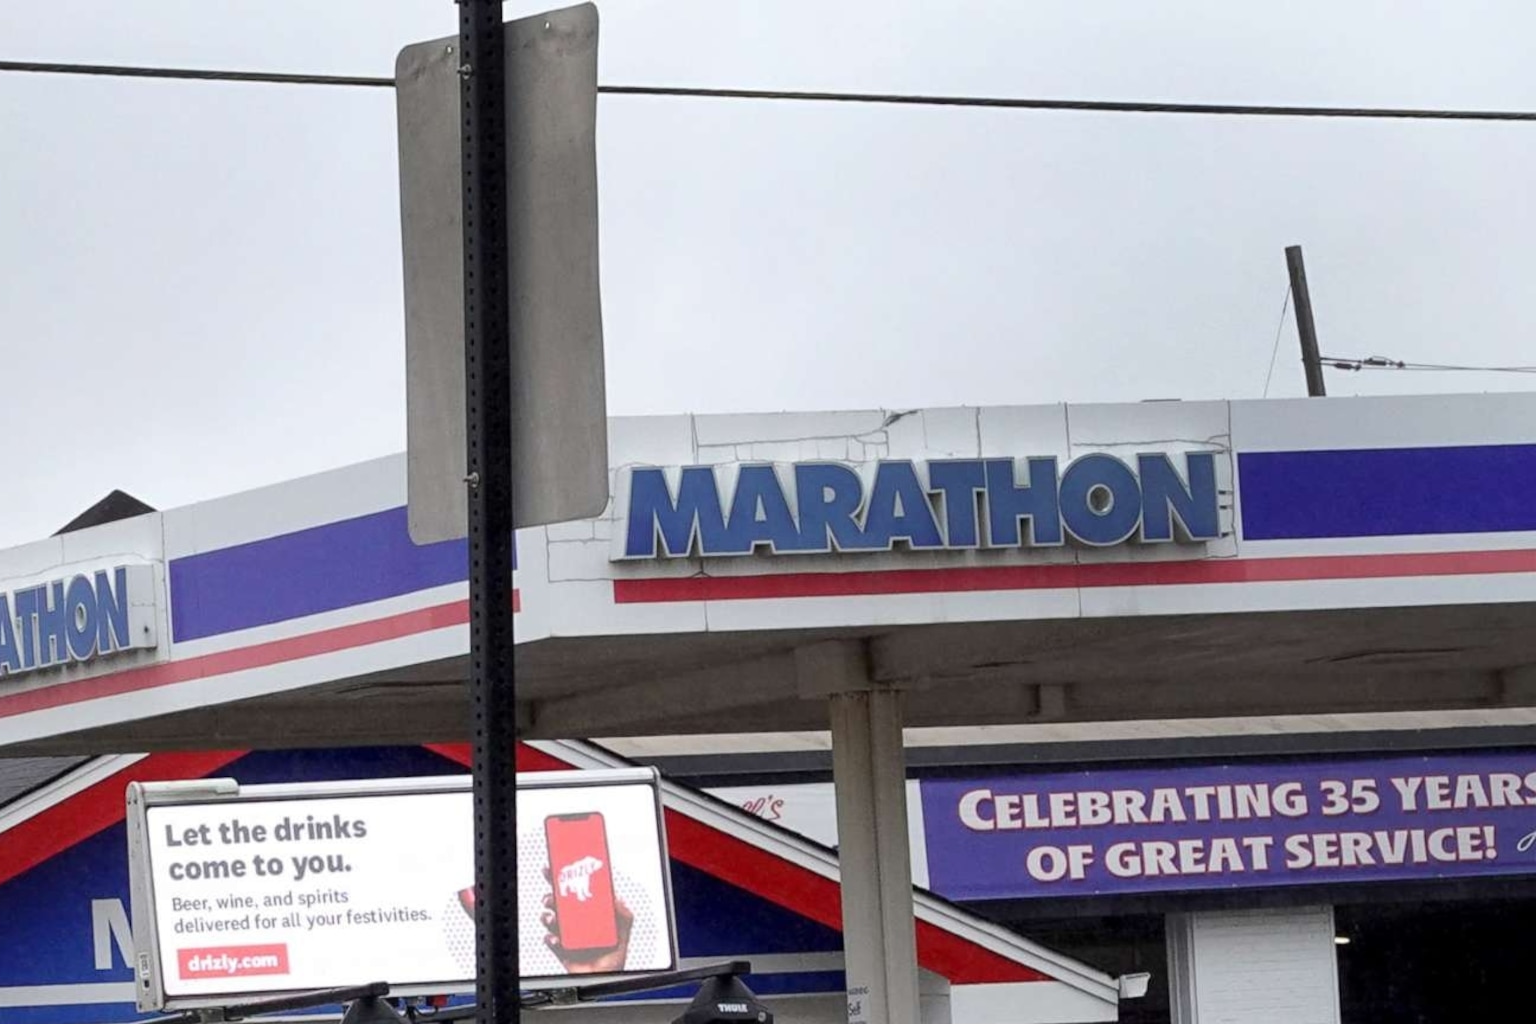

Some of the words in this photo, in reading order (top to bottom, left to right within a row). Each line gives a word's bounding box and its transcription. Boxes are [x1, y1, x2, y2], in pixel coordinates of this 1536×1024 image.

[622, 451, 1220, 559] MARATHON
[957, 780, 1309, 831] CELEBRATING
[1320, 778, 1380, 815] 35
[165, 823, 212, 847] Let
[219, 819, 267, 844] the
[274, 814, 367, 842] drinks
[1025, 840, 1094, 881] OF
[1105, 835, 1275, 879] GREAT
[1285, 825, 1498, 869] SERVICE!
[169, 859, 246, 880] come
[252, 855, 284, 876] to
[291, 854, 352, 881] you.
[172, 897, 212, 912] Beer,
[216, 894, 259, 909] wine,
[263, 890, 293, 907] and
[298, 889, 349, 908] spirits
[174, 915, 250, 934] delivered
[254, 914, 277, 929] for
[281, 912, 301, 928] all
[306, 912, 342, 931] your
[346, 907, 432, 924] festivities.
[188, 953, 278, 974] drizly.com
[717, 1003, 748, 1013] THULE
